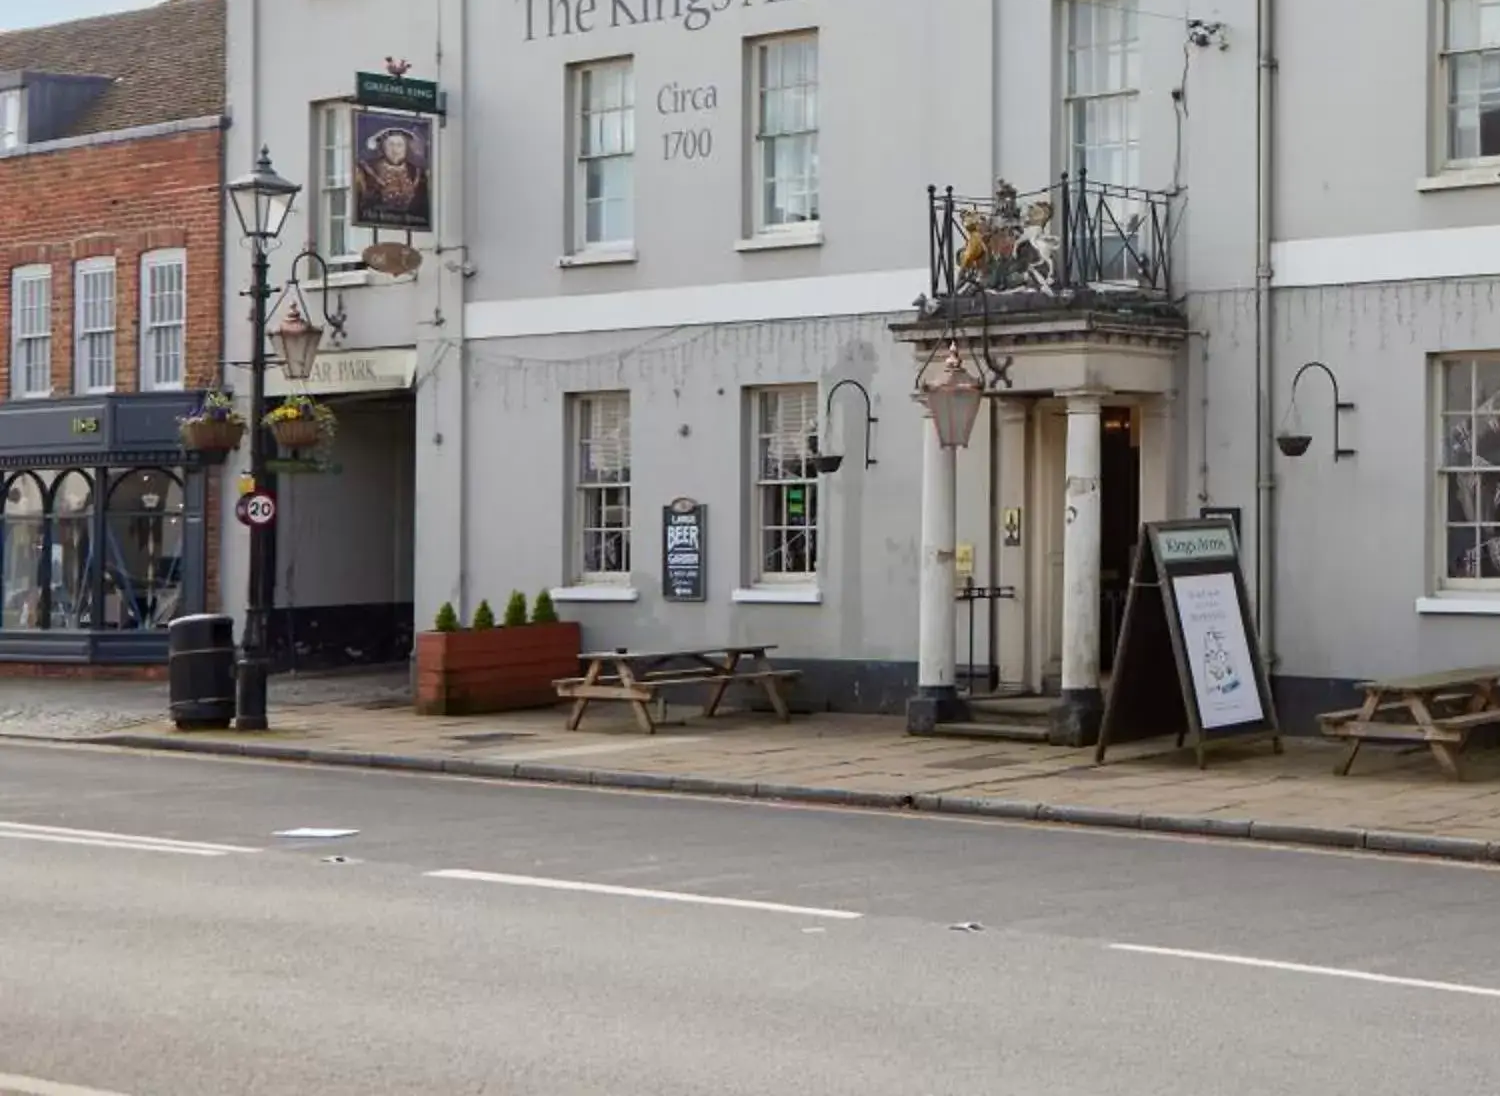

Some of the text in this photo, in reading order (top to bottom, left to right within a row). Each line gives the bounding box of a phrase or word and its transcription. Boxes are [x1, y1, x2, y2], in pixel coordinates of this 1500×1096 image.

[656, 82, 717, 115] Circa
[662, 128, 712, 161] 1700
[311, 358, 379, 384] AR PARK
[250, 501, 271, 516] 20
[668, 525, 699, 551] BEER
